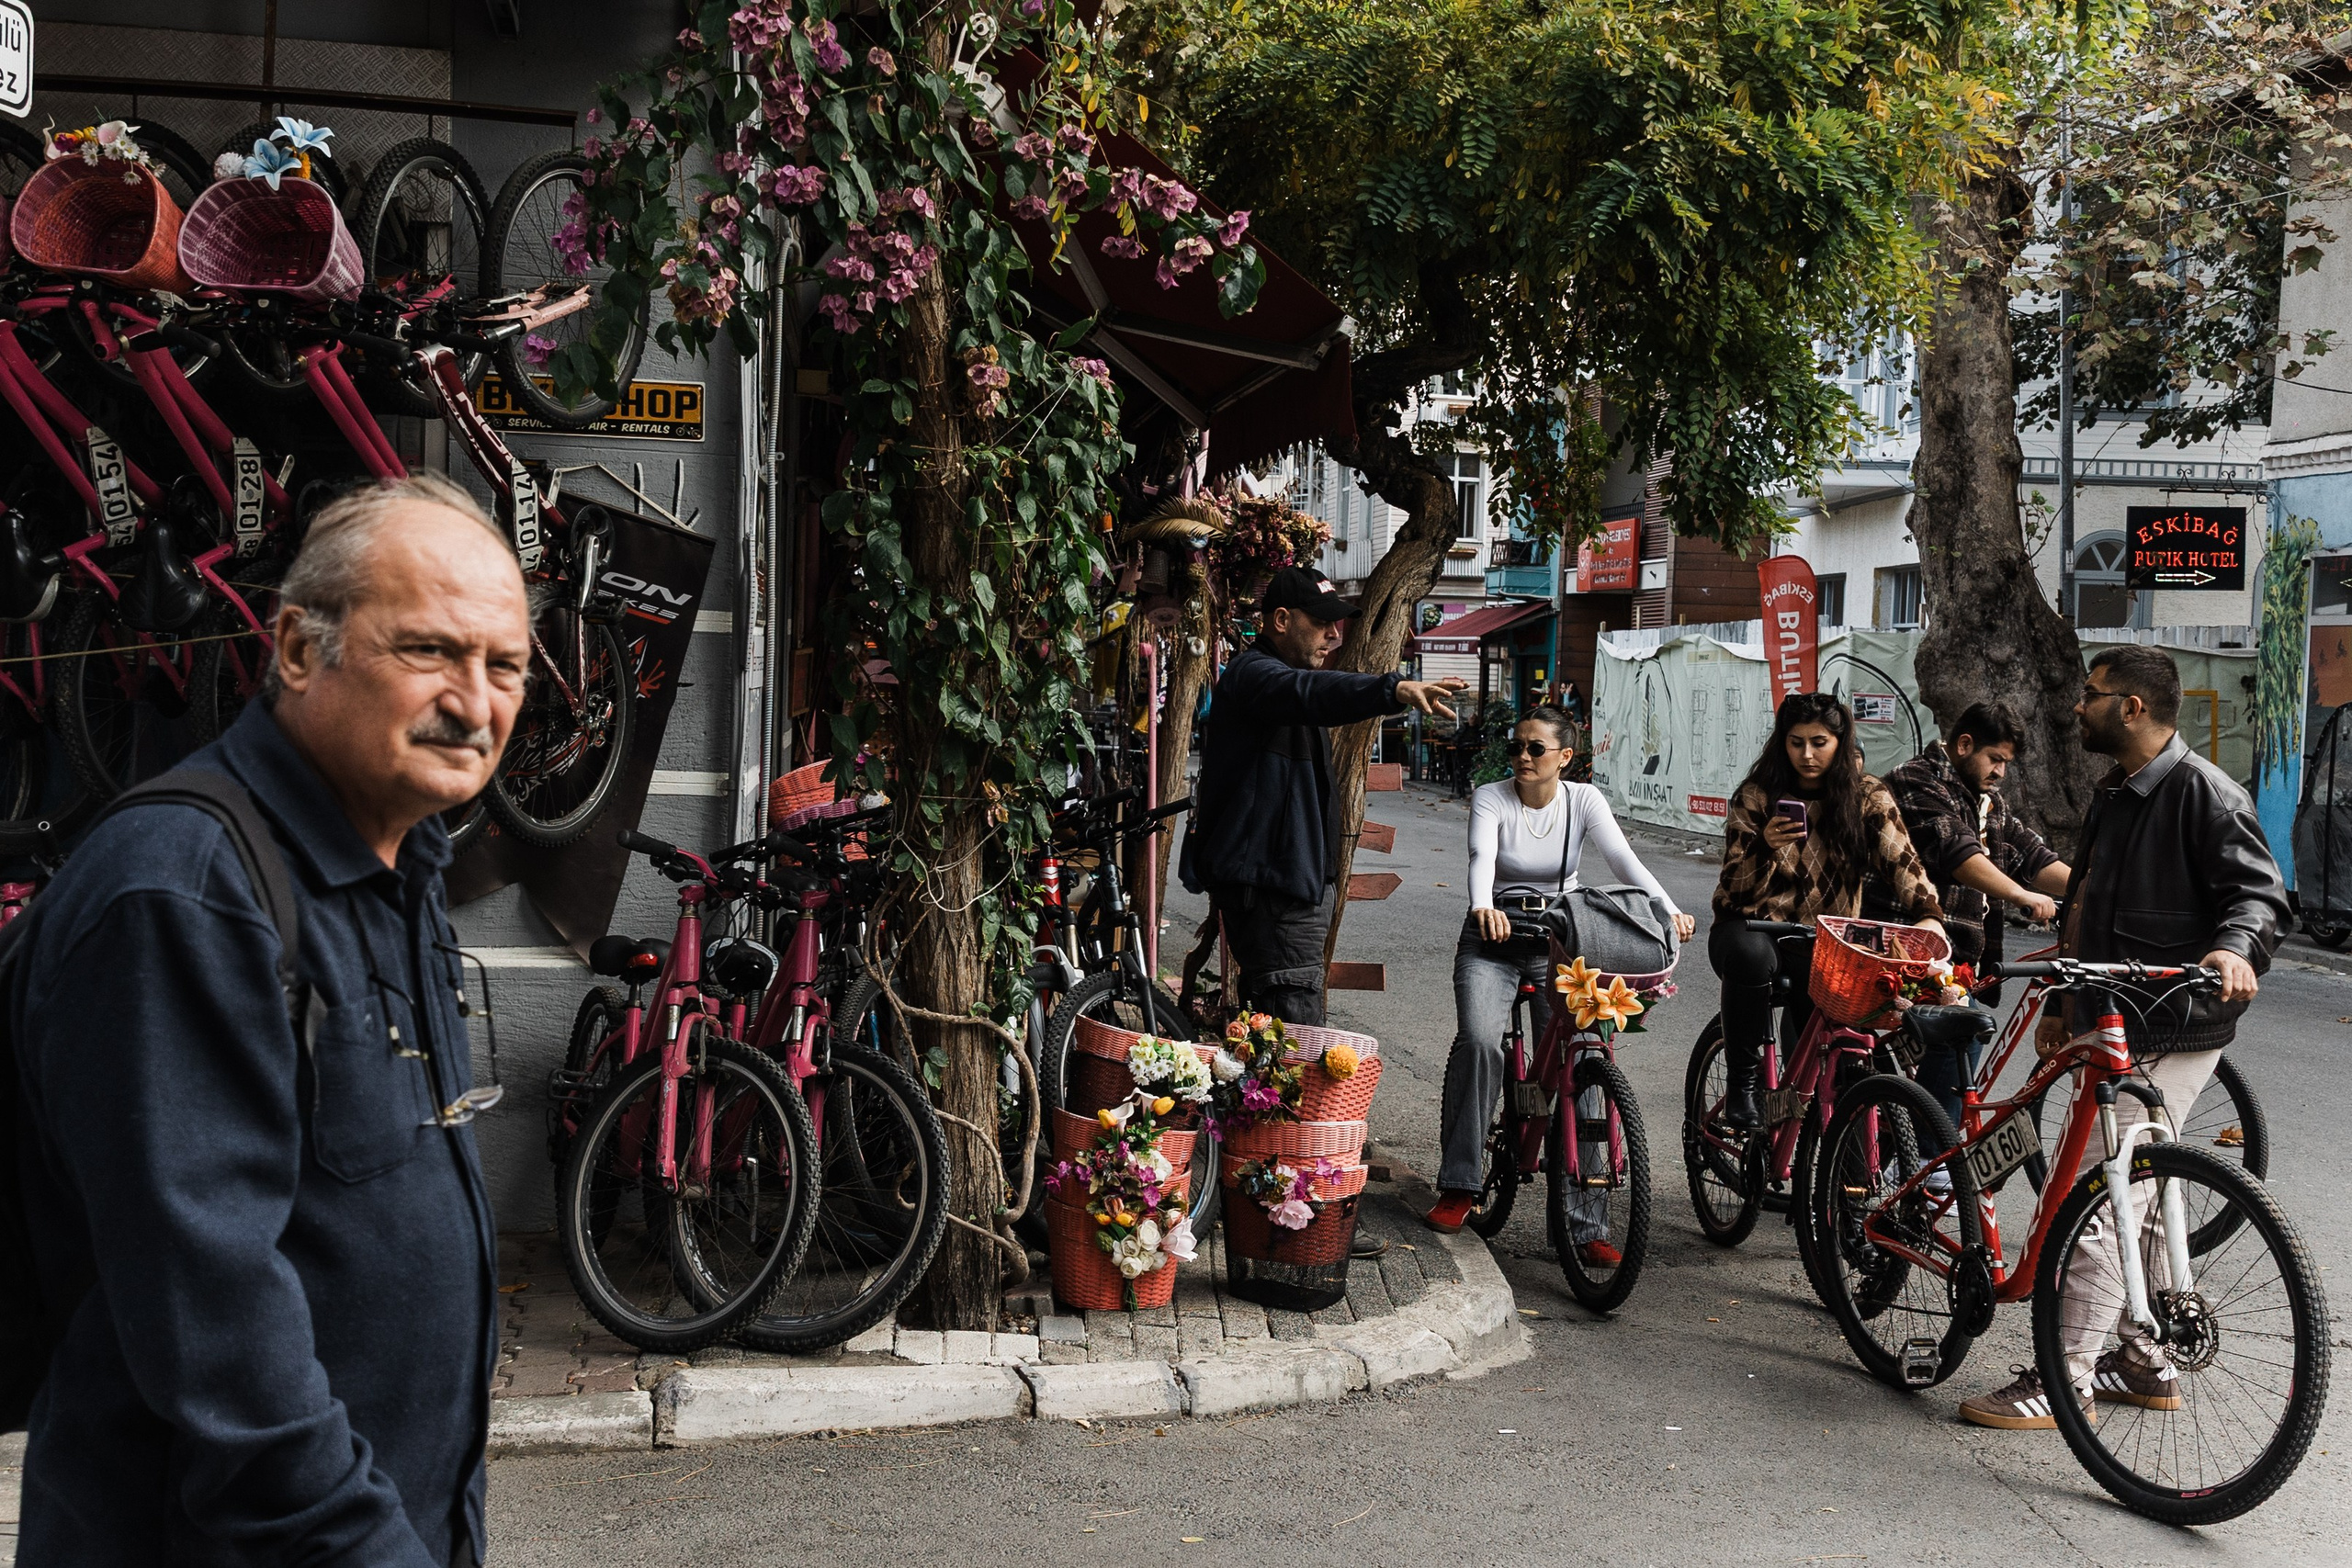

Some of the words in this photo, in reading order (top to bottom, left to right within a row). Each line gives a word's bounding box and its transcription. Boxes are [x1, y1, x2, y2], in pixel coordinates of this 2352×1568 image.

[0, 15, 21, 52] lü
[614, 387, 698, 420] HOP
[508, 417, 553, 429] SERVI
[621, 423, 671, 434] RENTALS
[96, 444, 130, 518] 0154
[239, 458, 262, 529] 0128
[516, 477, 537, 546] 0114
[2136, 512, 2239, 545] ESKİBAĞ
[2188, 551, 2239, 568] HOTEL
[2037, 1059, 2058, 1078] 450
[1974, 1125, 2022, 1178] 0160
